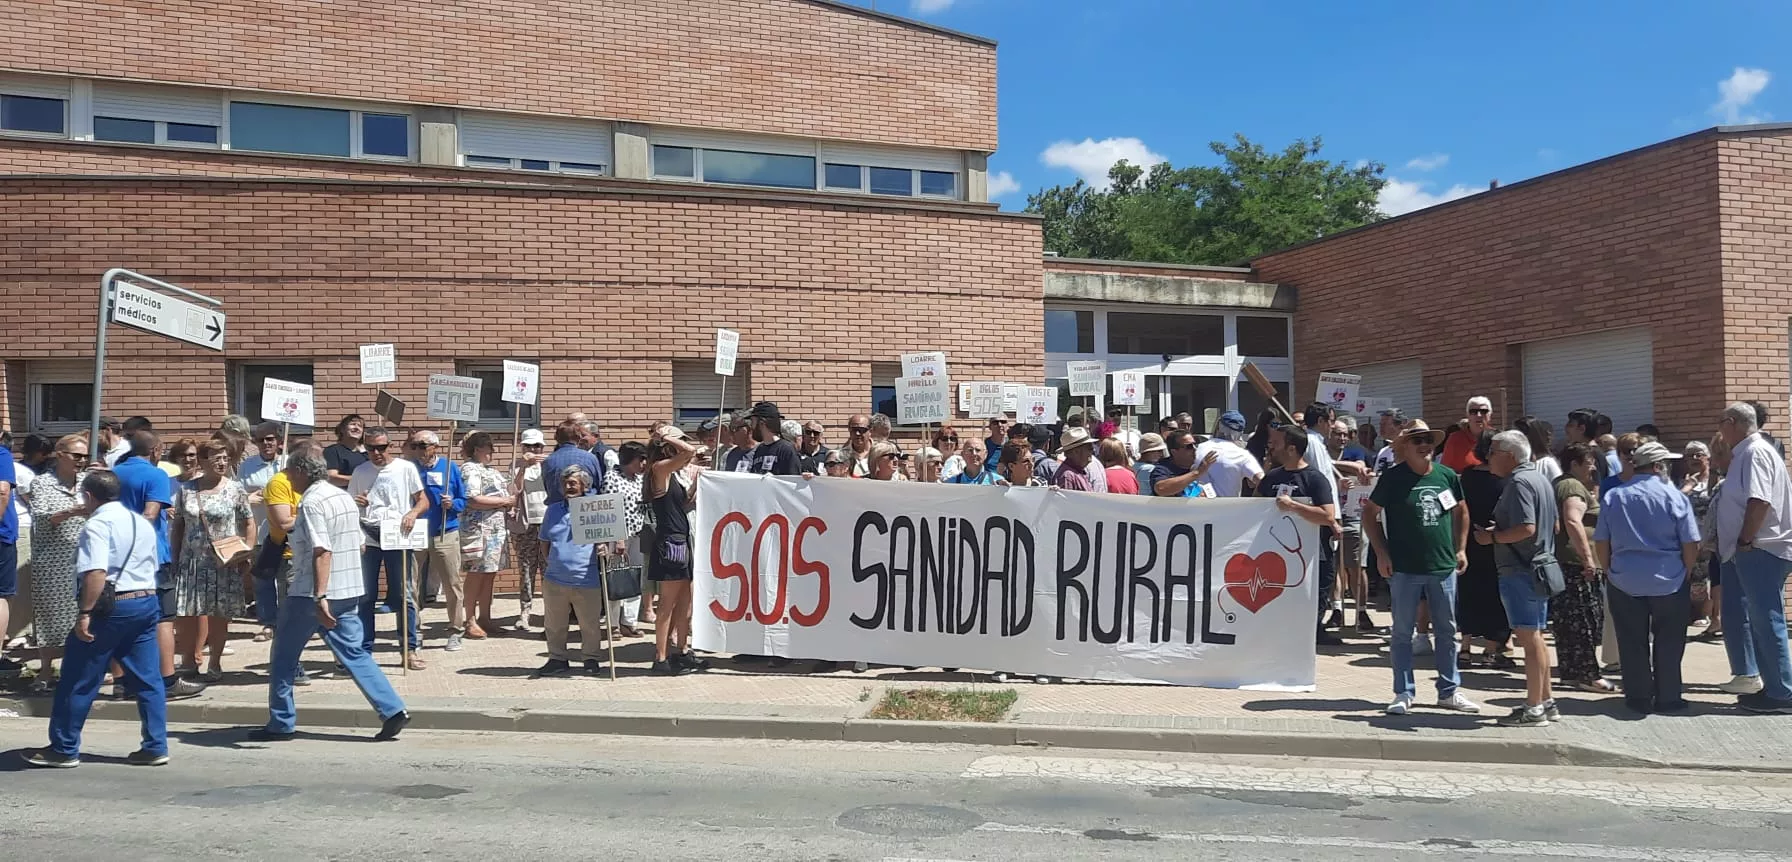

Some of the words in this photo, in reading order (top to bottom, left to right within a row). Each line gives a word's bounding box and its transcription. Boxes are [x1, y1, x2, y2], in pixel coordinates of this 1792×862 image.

[119, 288, 162, 310] servicios
[117, 305, 157, 325] médicos
[910, 355, 937, 364] LOARRE
[365, 359, 393, 378] SOS
[1027, 387, 1052, 398] TRISTE
[1072, 382, 1100, 393] RURAL
[433, 390, 476, 417] SOS
[904, 404, 944, 419] RURAL
[973, 397, 1001, 415] SOS
[580, 499, 615, 512] AYERBE
[585, 527, 615, 540] RURAL
[1055, 520, 1237, 645] RURAL
